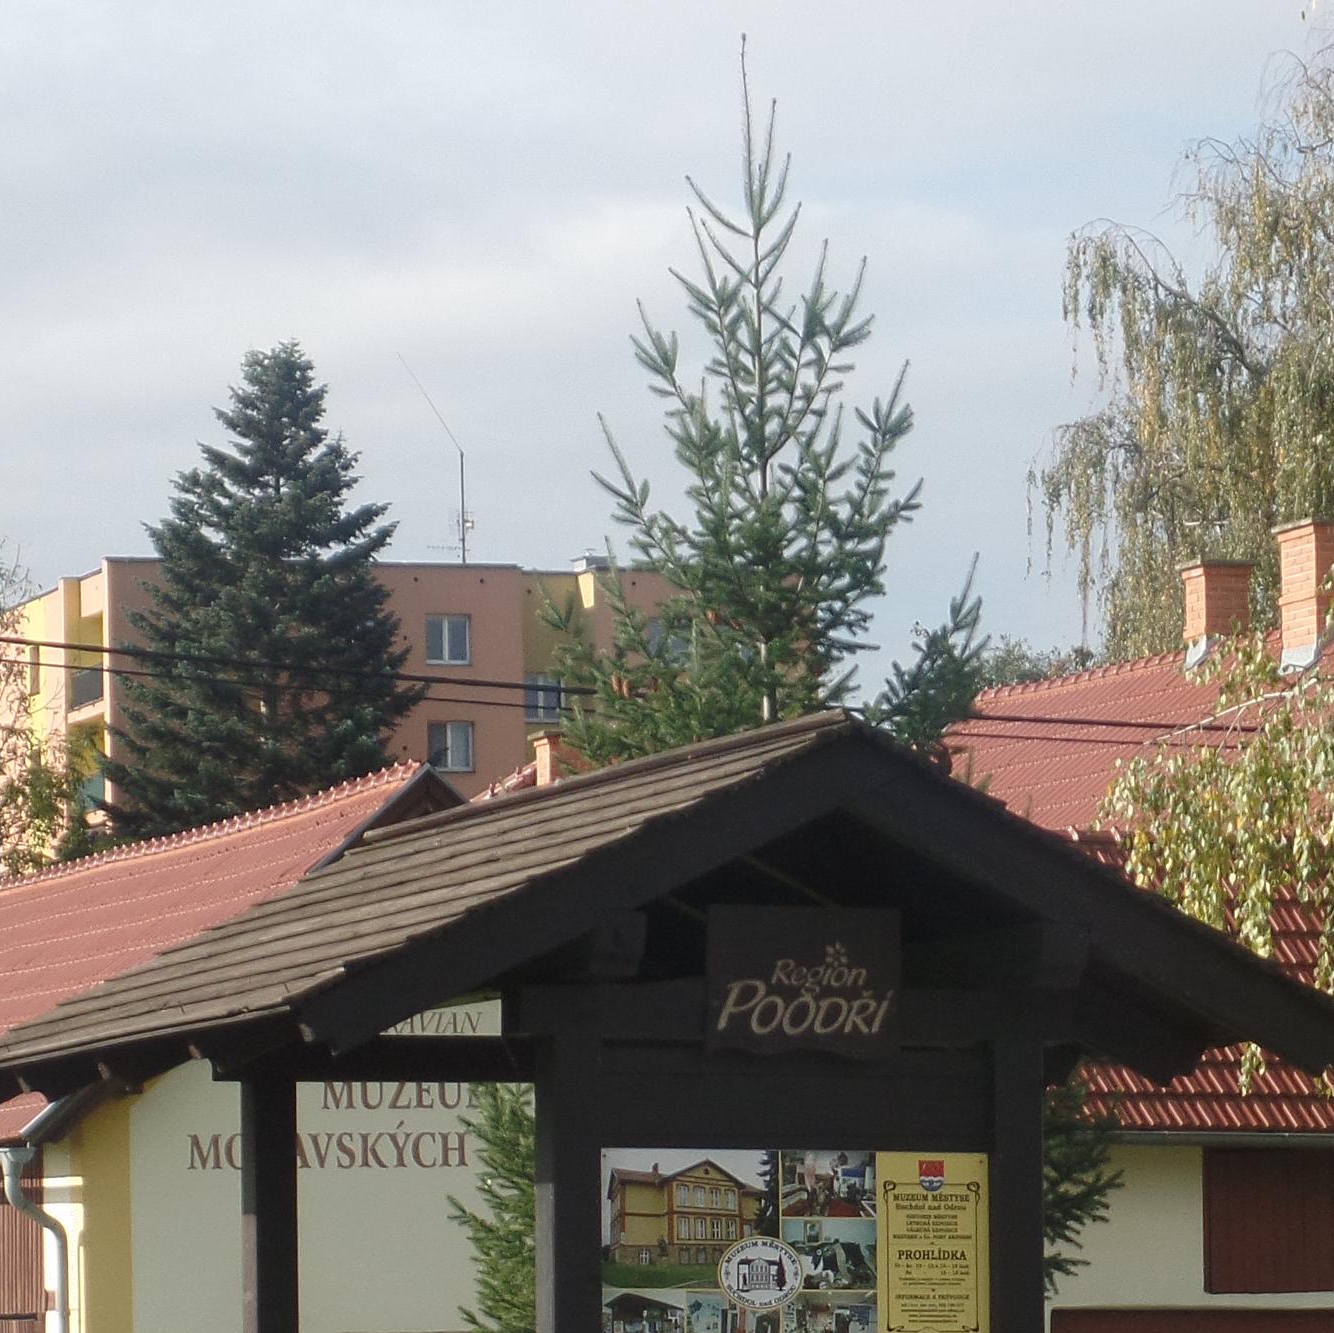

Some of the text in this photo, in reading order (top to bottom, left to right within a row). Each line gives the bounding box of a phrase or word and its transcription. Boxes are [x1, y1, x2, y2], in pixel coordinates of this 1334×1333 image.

[770, 958, 868, 996] Region
[717, 978, 895, 1035] POODŘÍ
[321, 1081, 479, 1110] MUZEU
[893, 1192, 970, 1202] MUZEUM MĚSTYSE
[898, 1247, 967, 1261] PROHLÍDKA
